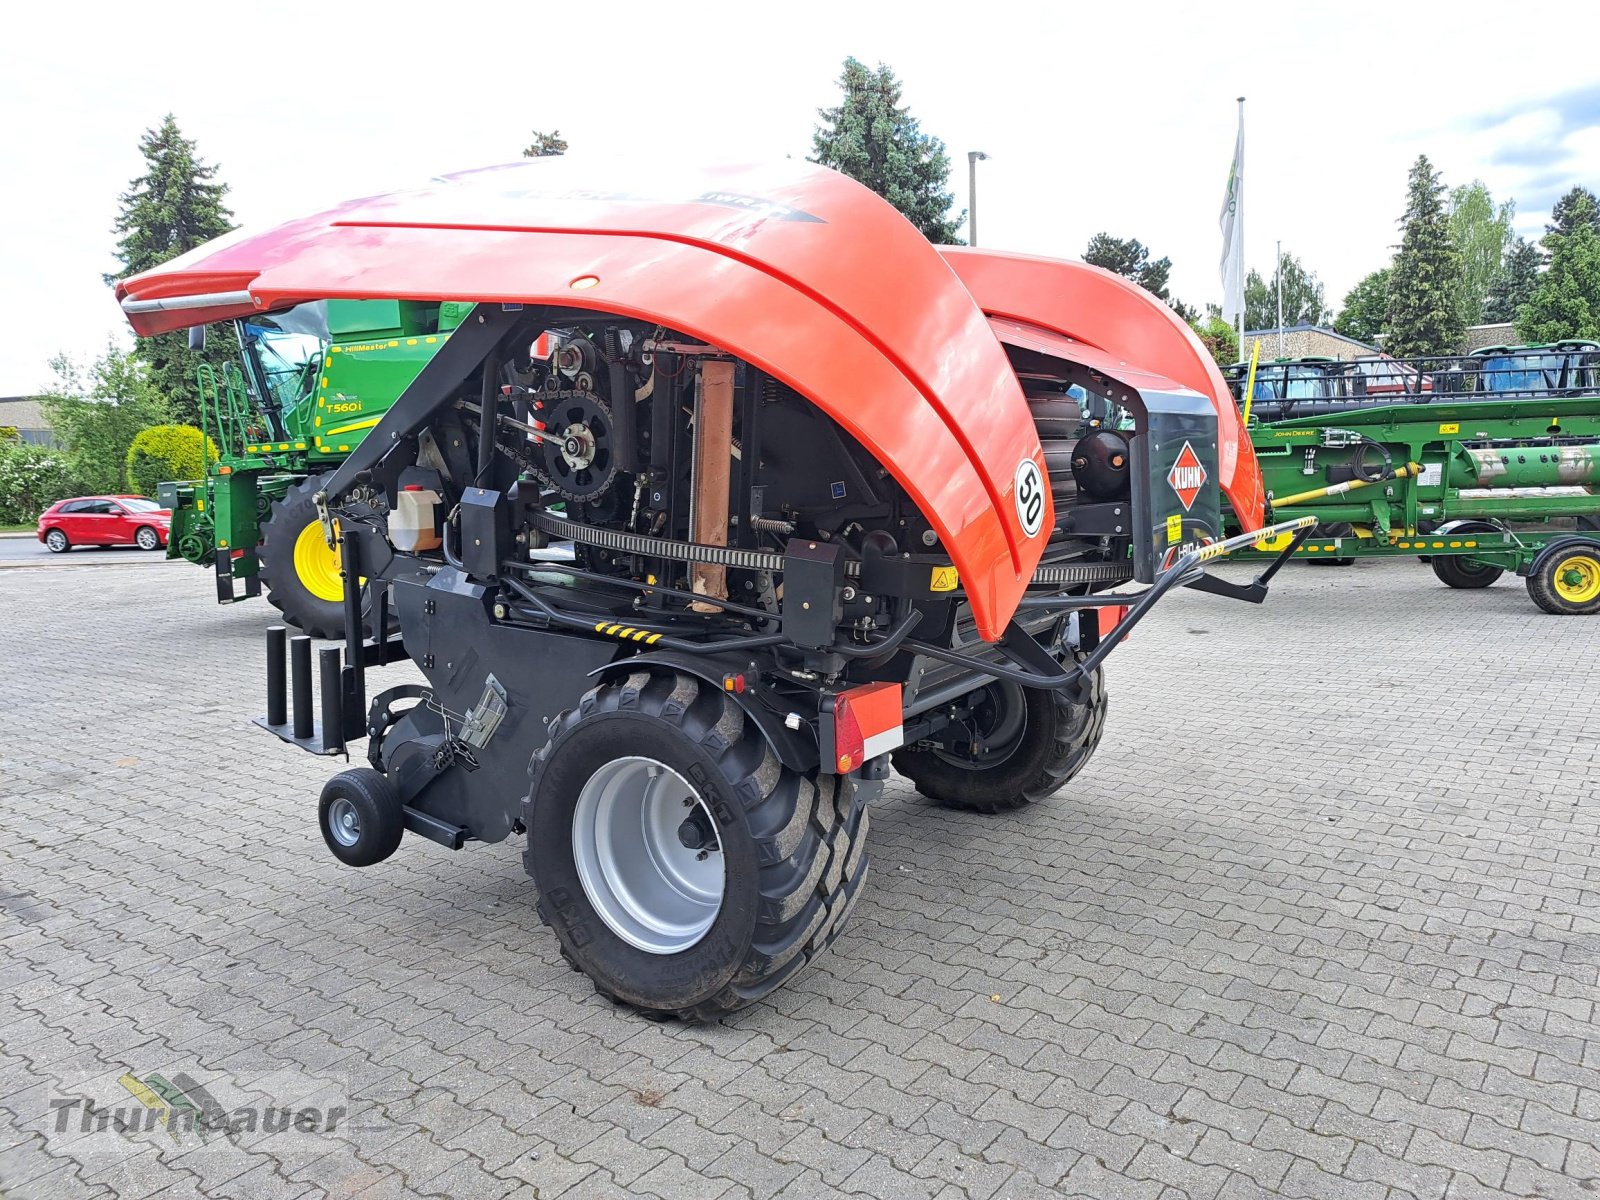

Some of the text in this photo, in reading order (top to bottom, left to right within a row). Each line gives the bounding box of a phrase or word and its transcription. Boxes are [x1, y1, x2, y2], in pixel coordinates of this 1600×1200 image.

[345, 343, 388, 353] HillMaster
[326, 401, 362, 414] T560i
[1175, 466, 1201, 490] KUHN
[1020, 467, 1041, 526] 50
[688, 763, 735, 825] BKT
